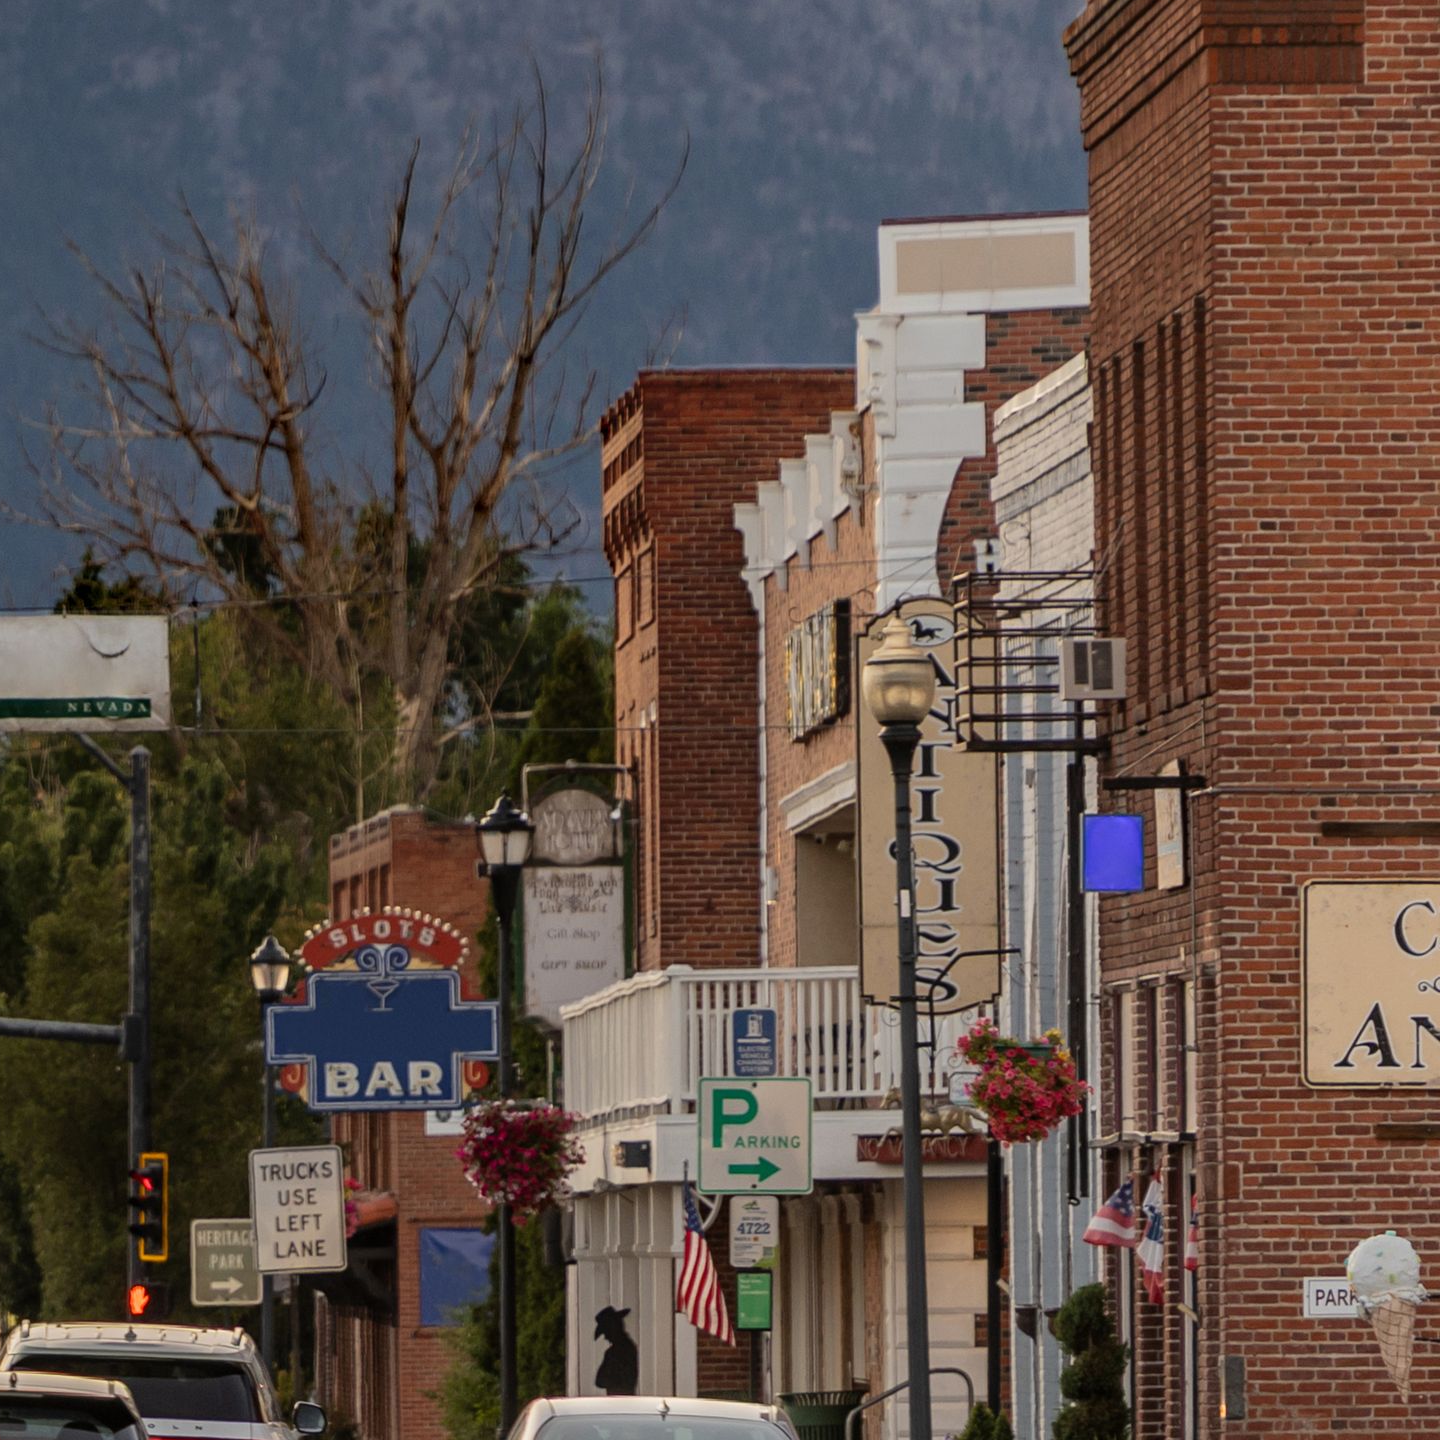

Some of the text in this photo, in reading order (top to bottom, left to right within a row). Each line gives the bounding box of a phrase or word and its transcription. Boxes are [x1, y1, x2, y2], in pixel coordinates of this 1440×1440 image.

[67, 701, 147, 713] NEVADA
[328, 919, 436, 949] SLOTS
[324, 1061, 443, 1097] BAR
[260, 1161, 333, 1181] TRUCKS
[278, 1188, 317, 1206] USE
[275, 1214, 322, 1232] LEFT
[736, 1222, 771, 1234] 4722
[275, 1240, 327, 1259] LANE
[209, 1253, 245, 1270] PARK
